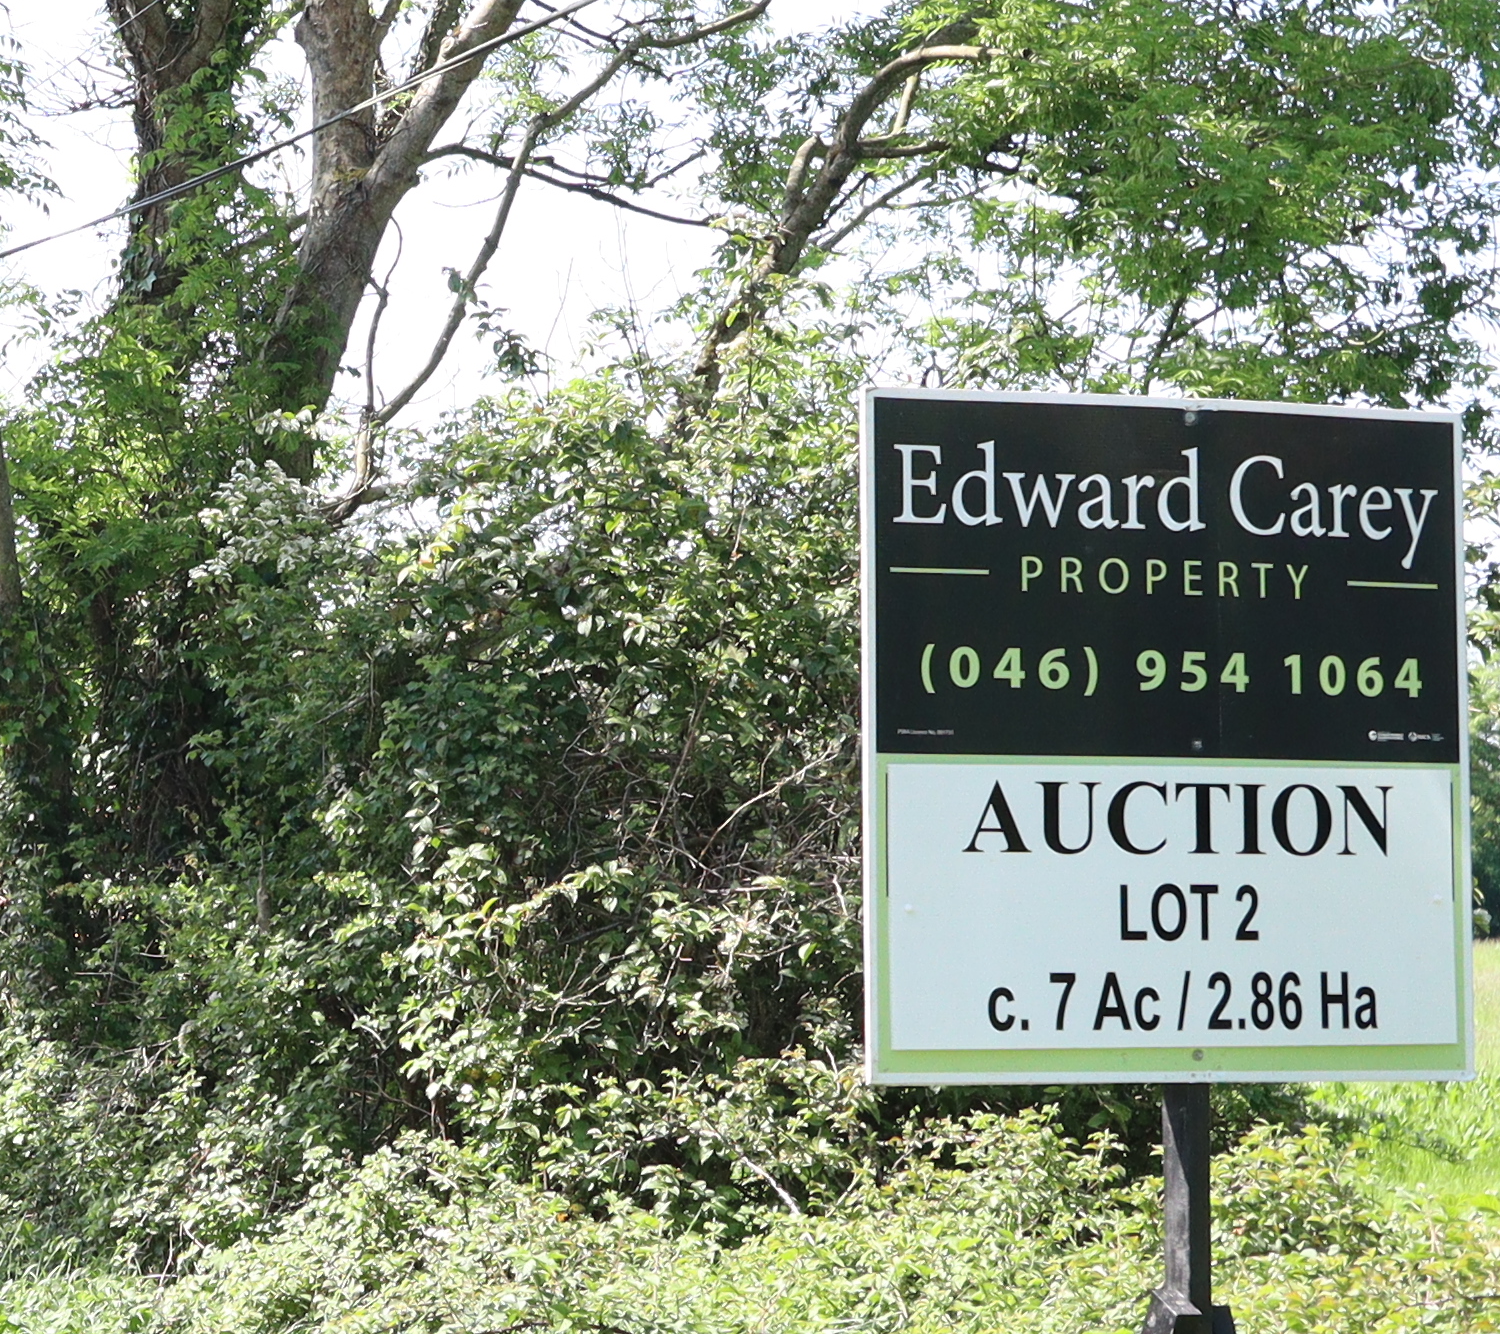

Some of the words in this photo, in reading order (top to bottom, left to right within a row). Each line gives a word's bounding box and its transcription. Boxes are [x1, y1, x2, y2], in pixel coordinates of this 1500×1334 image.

[892, 439, 1207, 532] Edward
[1229, 454, 1439, 570] Carey
[1021, 555, 1309, 600] PROPERTY
[920, 643, 1098, 697] (046)
[1136, 649, 1250, 693] 954
[1283, 654, 1423, 698] 1064
[963, 780, 1393, 857] AUCTION
[1120, 883, 1219, 942] LOT
[1235, 884, 1260, 942] 2
[988, 986, 1030, 1032] c.
[1049, 972, 1077, 1031] 7
[1093, 971, 1161, 1031] Ac
[1207, 971, 1303, 1031] 2.86
[1320, 971, 1378, 1030] Ha
